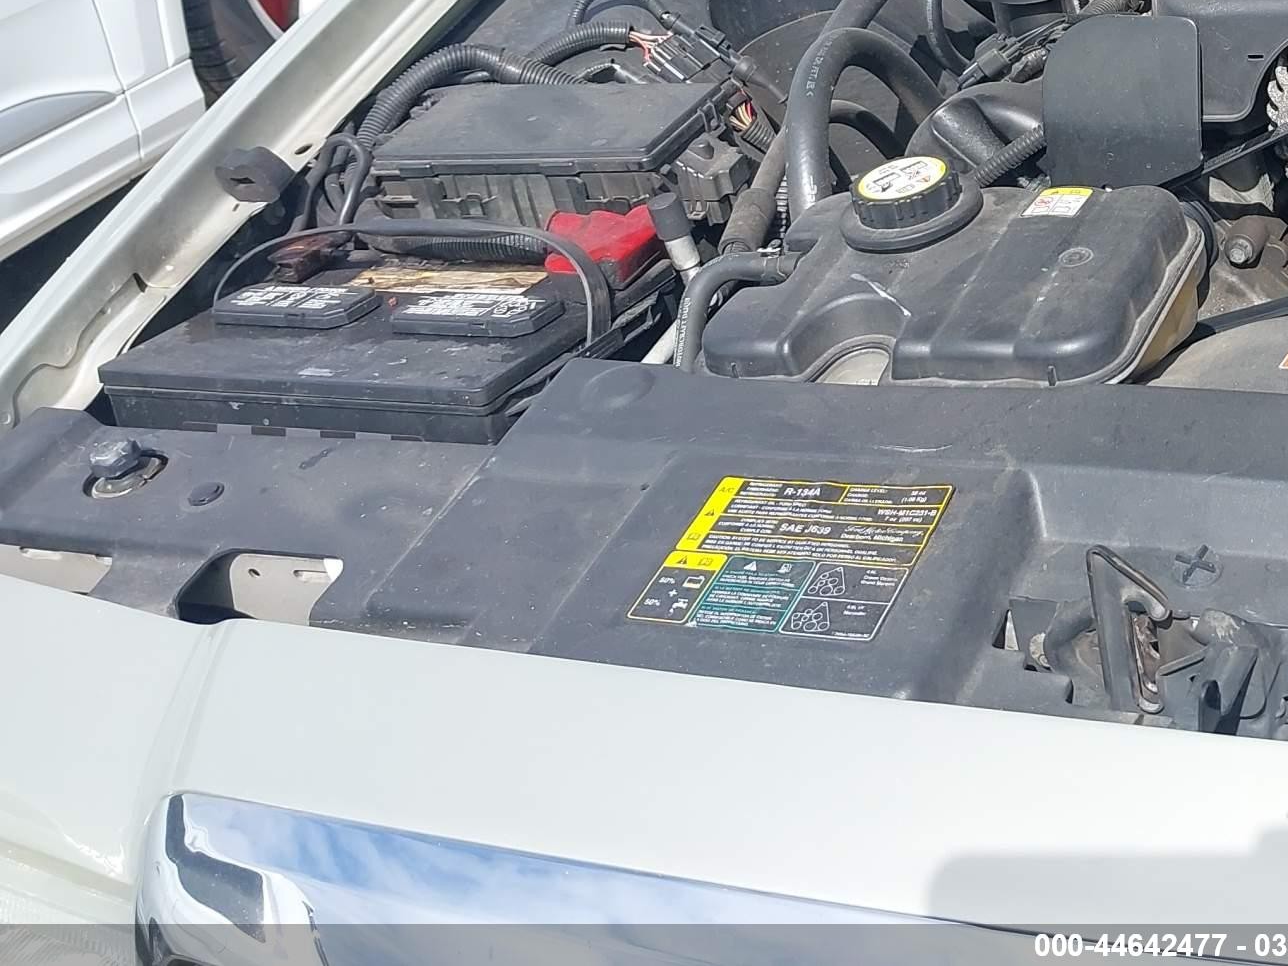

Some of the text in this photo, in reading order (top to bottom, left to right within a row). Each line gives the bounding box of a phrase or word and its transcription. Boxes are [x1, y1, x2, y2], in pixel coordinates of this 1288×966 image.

[783, 487, 821, 497] R-134A
[779, 523, 804, 533] SAE
[804, 524, 832, 535] J639
